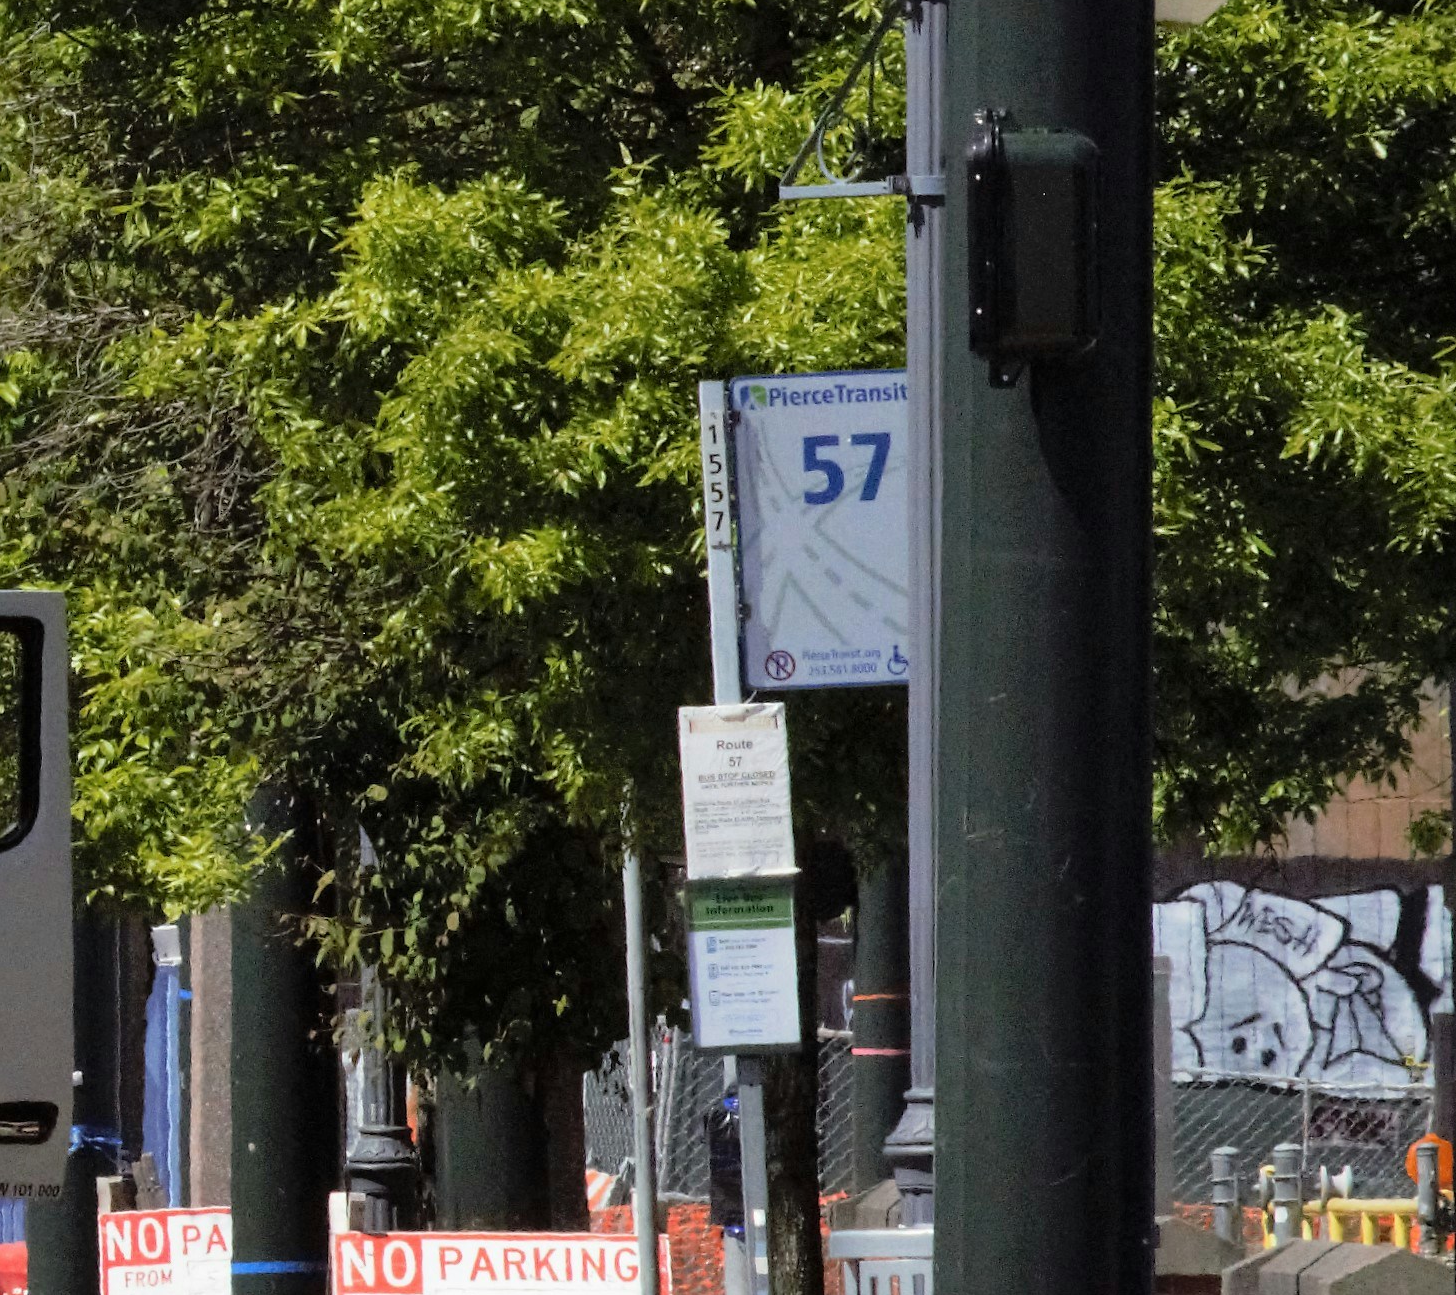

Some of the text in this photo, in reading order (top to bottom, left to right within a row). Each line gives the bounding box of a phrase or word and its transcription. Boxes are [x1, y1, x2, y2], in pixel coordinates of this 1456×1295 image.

[802, 431, 892, 505] 57
[716, 740, 753, 750] Route
[728, 756, 743, 767] 57
[105, 1217, 164, 1261] NO
[125, 1270, 173, 1288] FROM
[341, 1240, 640, 1287] NO PARKING
